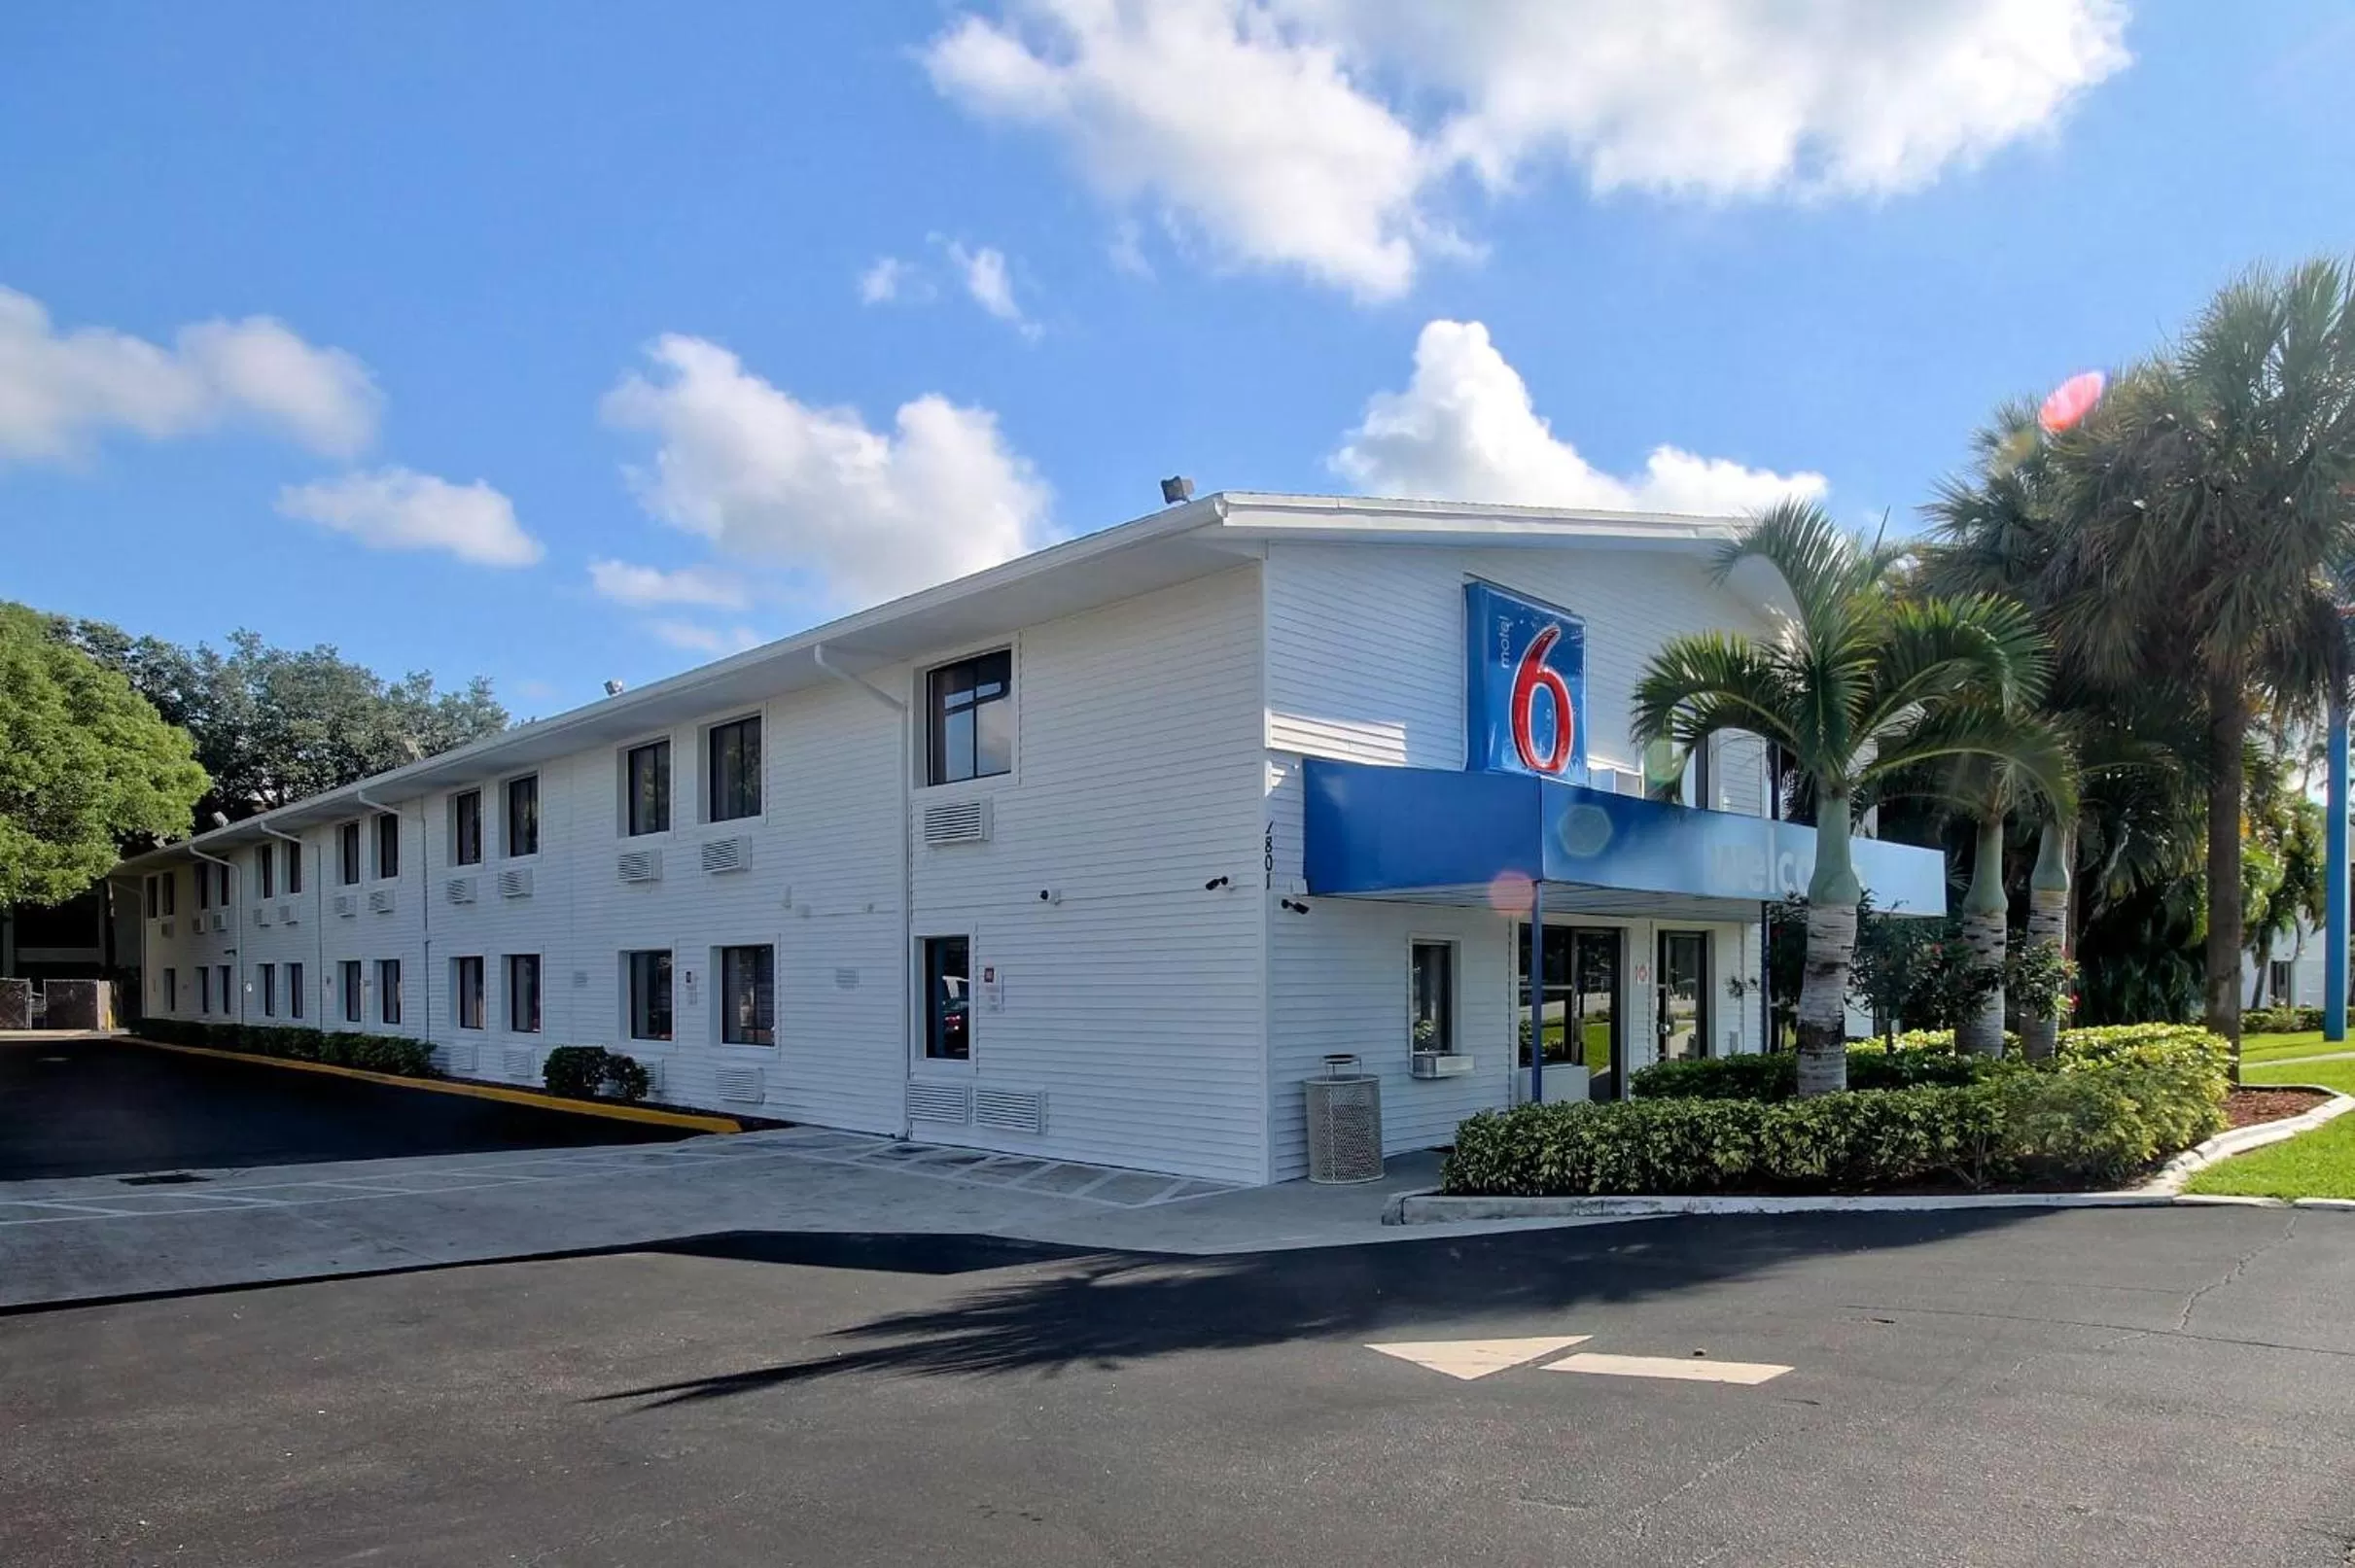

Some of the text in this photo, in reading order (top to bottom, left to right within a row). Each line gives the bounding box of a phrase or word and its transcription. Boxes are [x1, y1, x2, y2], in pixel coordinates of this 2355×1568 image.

[1498, 616, 1513, 669] motel
[1509, 624, 1573, 775] 6
[1713, 826, 1857, 895] Welco
